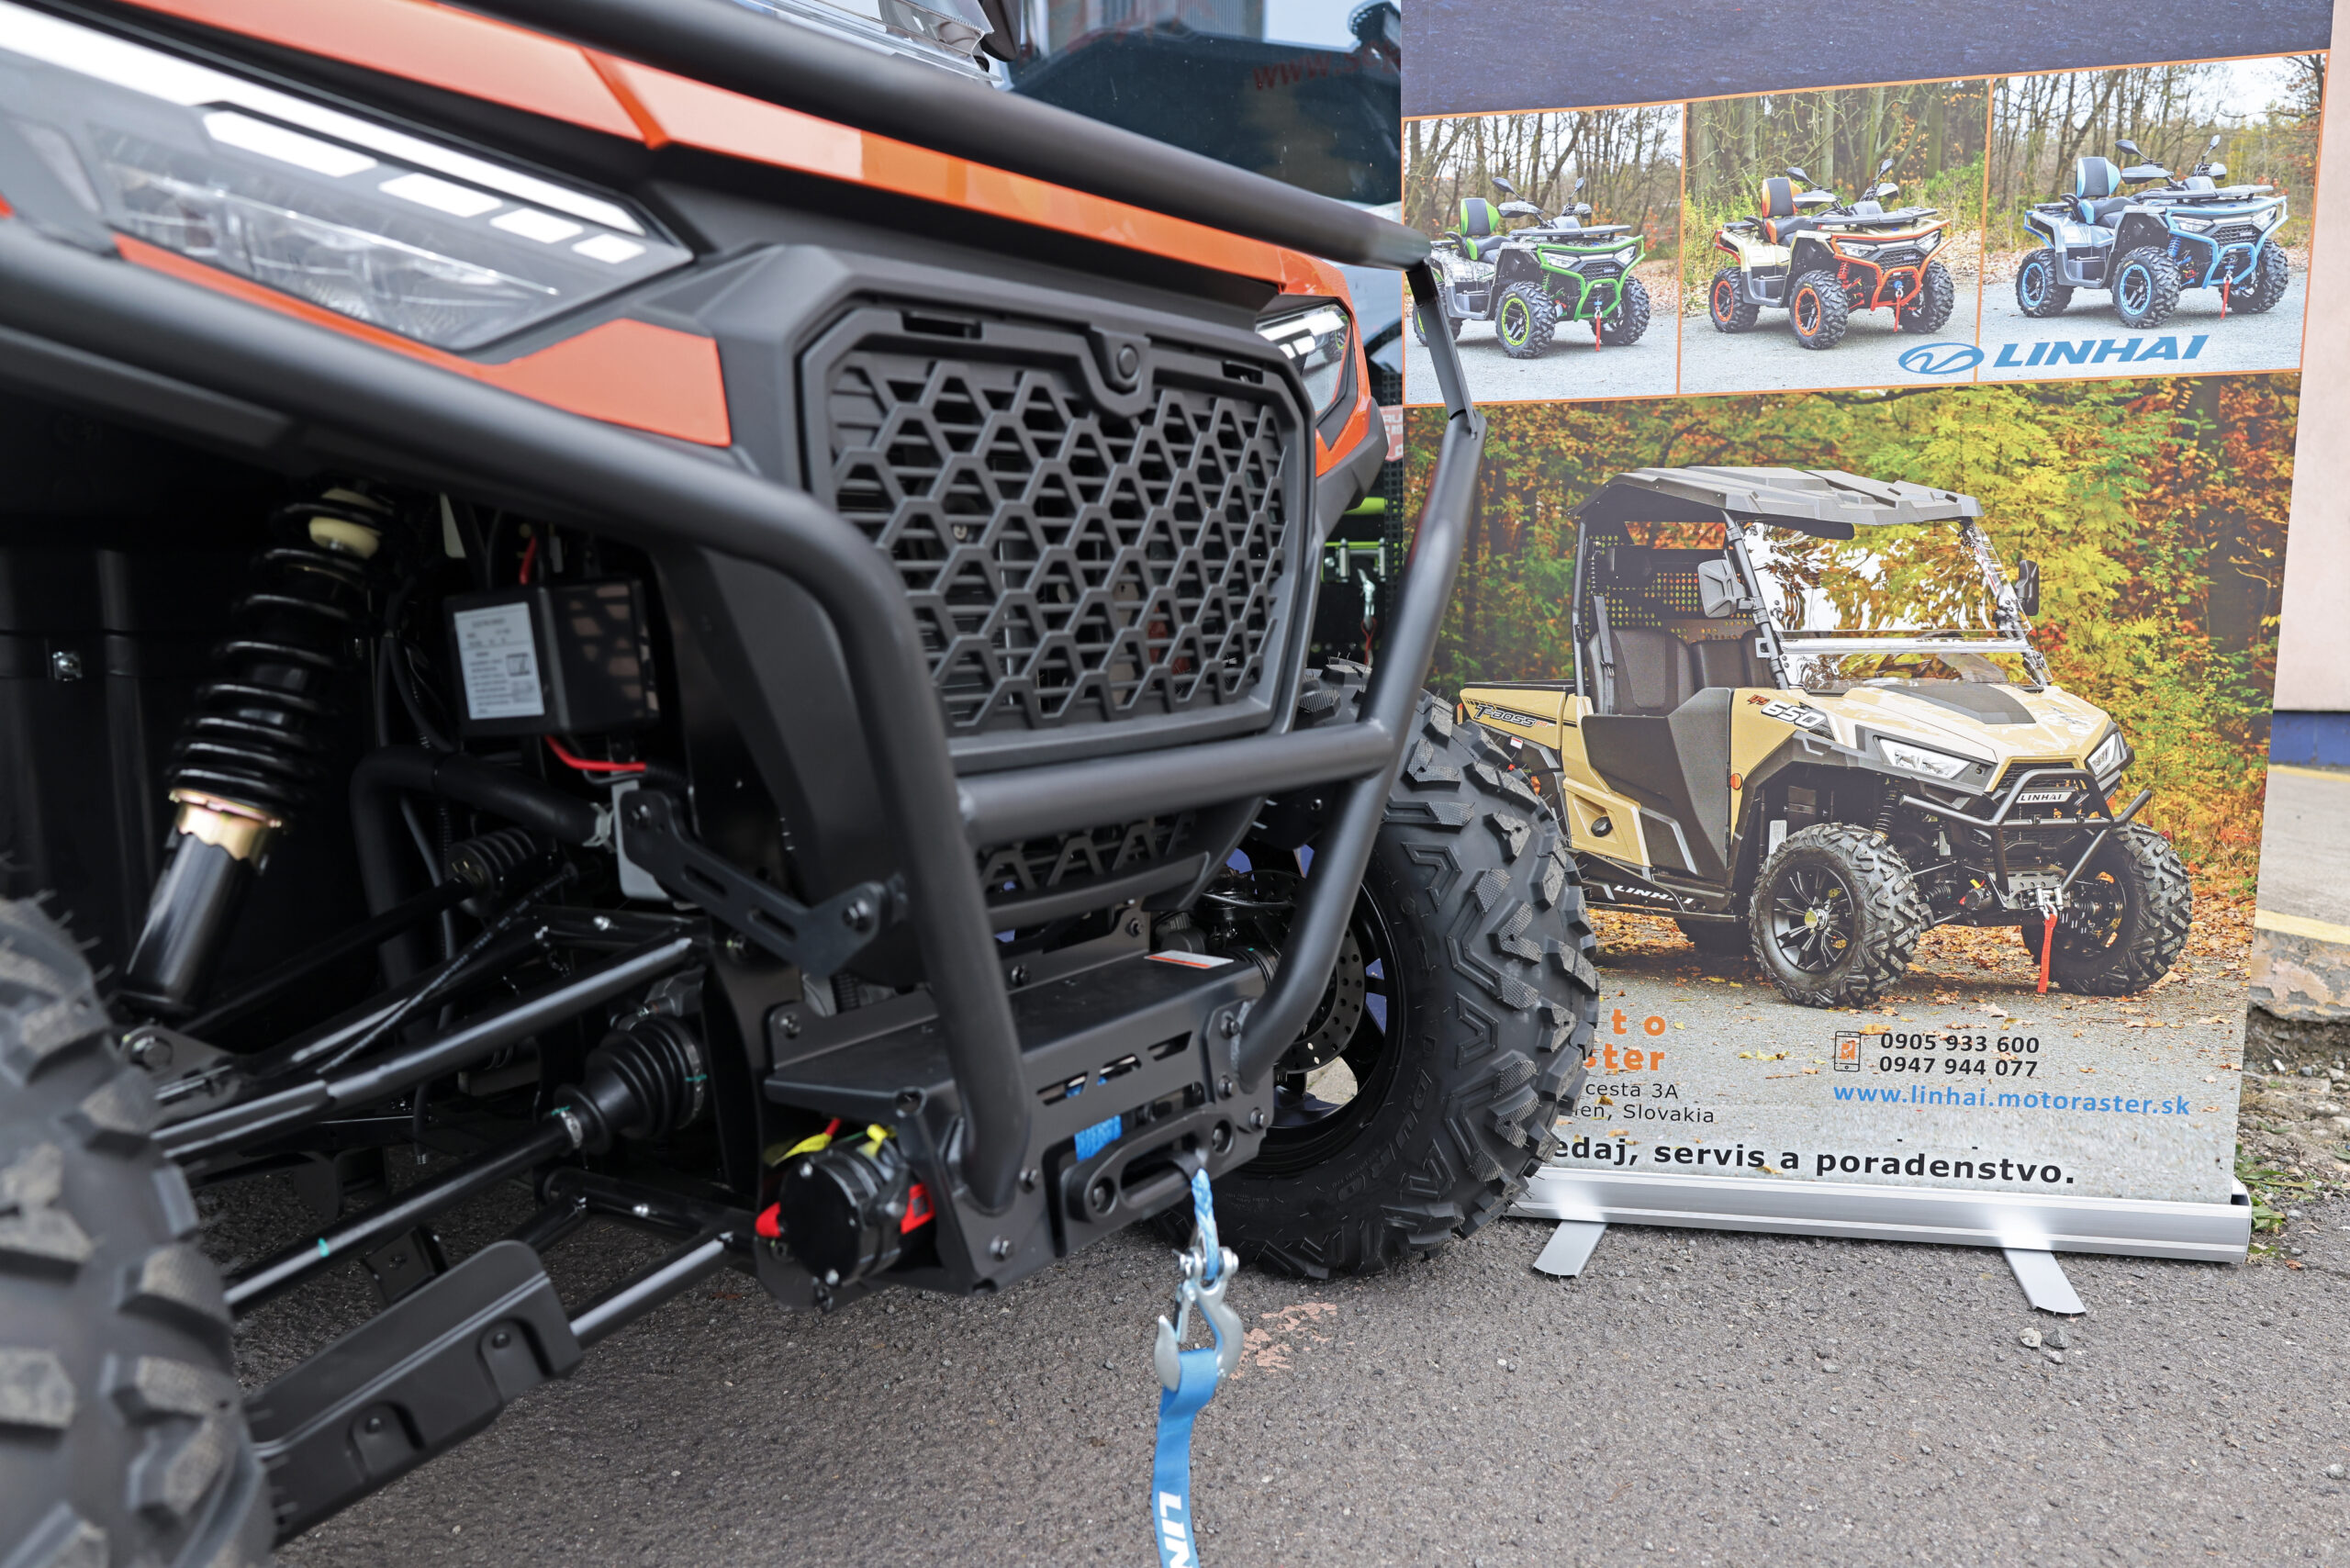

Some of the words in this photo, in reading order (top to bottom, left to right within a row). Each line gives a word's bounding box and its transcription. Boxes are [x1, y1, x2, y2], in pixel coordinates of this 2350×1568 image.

[1993, 335, 2210, 368] LINHAI
[1761, 700, 1826, 730] 650
[2020, 793, 2063, 801] LINHAI
[1881, 1033, 1937, 1051] 0905
[1946, 1035, 1987, 1052] 933
[1997, 1036, 2040, 1054] 600
[1879, 1056, 1936, 1073] 0947
[1944, 1058, 1986, 1075] 944
[1995, 1059, 2038, 1077] 077
[1585, 1081, 1641, 1098] cesta
[1651, 1082, 1679, 1100] 3A
[1833, 1084, 2191, 1115] www.linhai.motoraster.sk
[1623, 1103, 1715, 1125] Slovakia
[1654, 1144, 1765, 1170] servis
[1779, 1150, 1800, 1170] a
[1816, 1153, 2075, 1184] poradenstvo.
